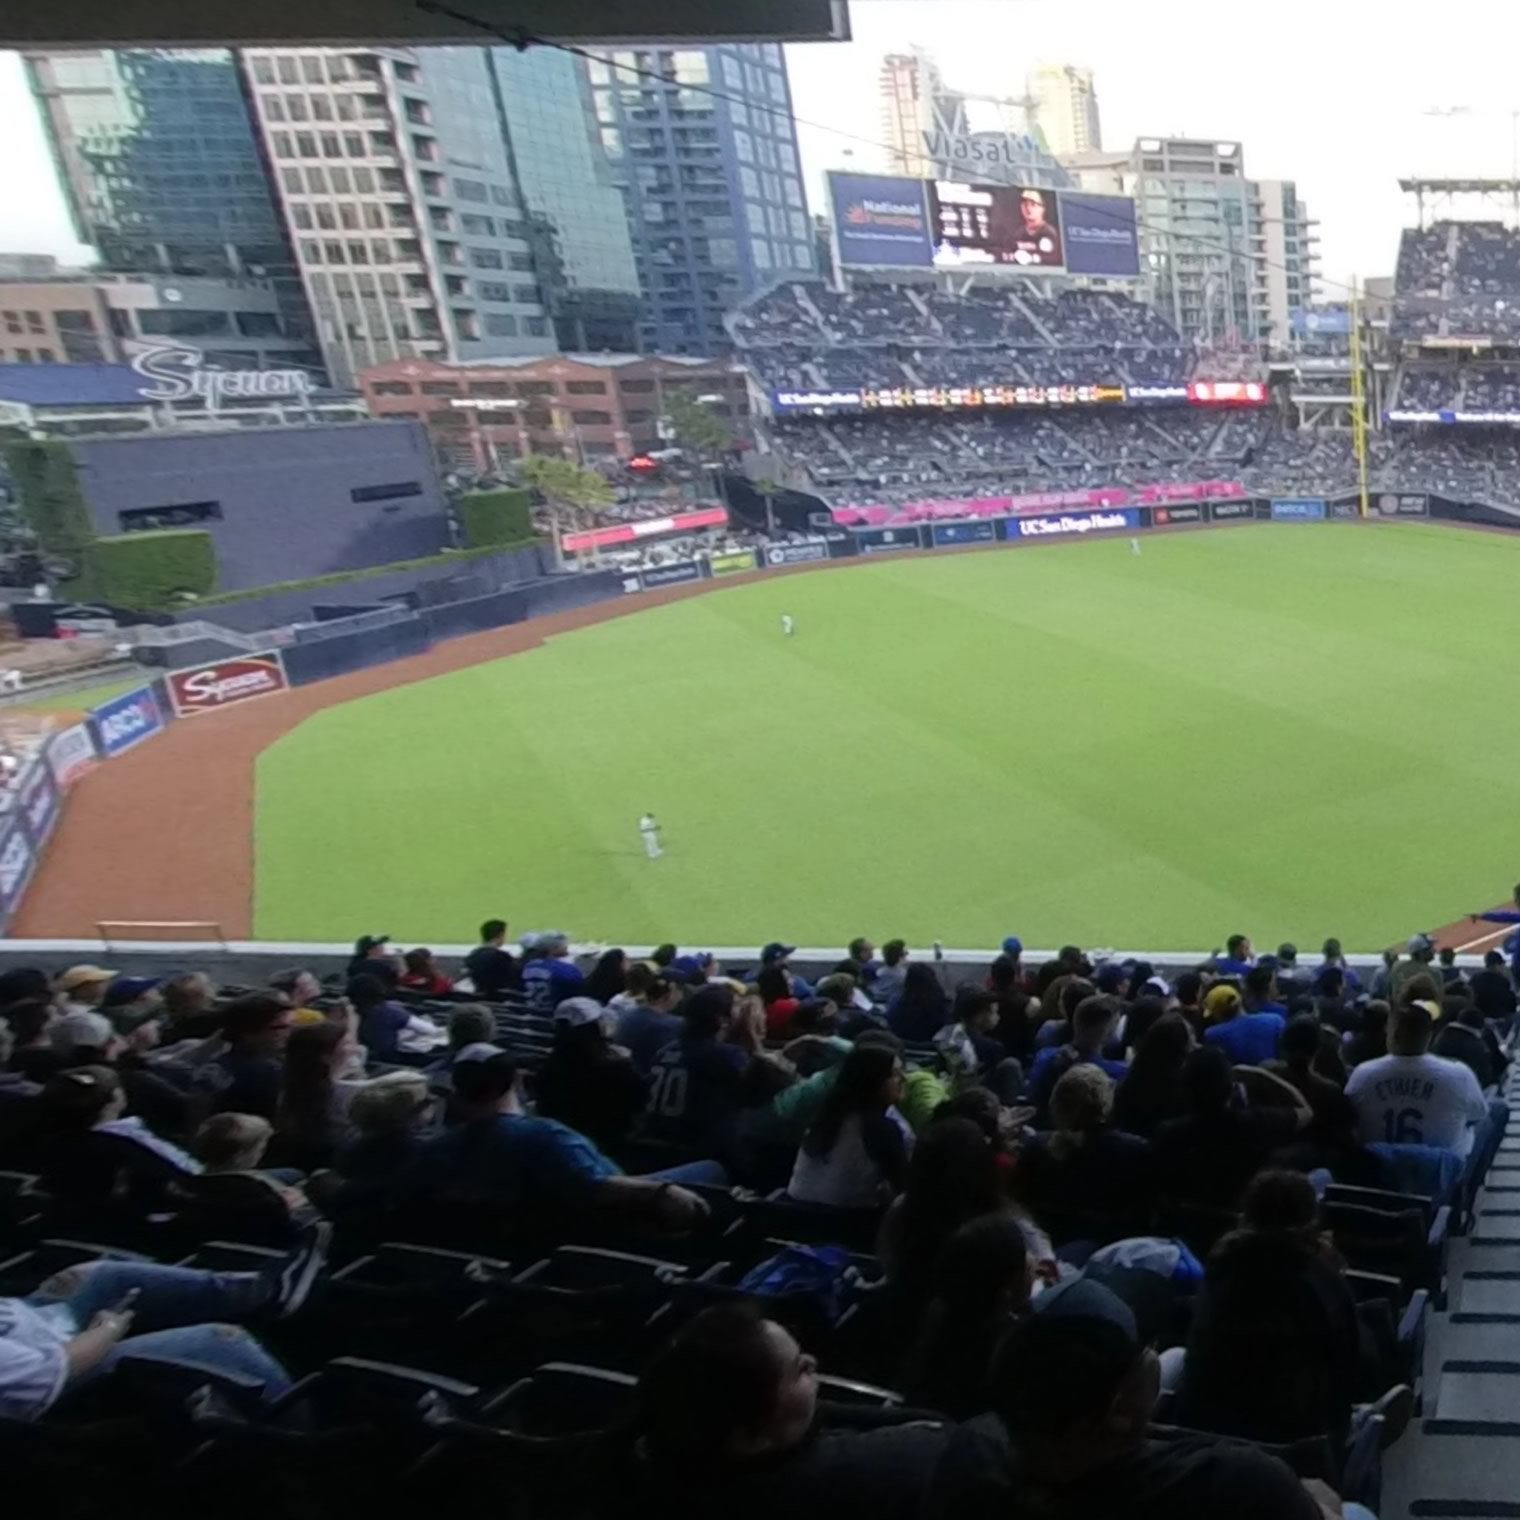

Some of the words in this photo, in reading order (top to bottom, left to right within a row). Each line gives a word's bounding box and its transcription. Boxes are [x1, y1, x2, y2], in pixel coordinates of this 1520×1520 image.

[922, 131, 1014, 163] Viasat
[863, 200, 920, 215] National
[131, 349, 318, 411] Sycuan
[1019, 519, 1039, 535] UC
[1039, 519, 1060, 533] San
[1060, 517, 1091, 533] Diego
[1090, 514, 1126, 529] Health
[183, 670, 271, 701] Sycuan
[1375, 1078, 1434, 1101] ETHIER
[1382, 1107, 1424, 1143] 16
